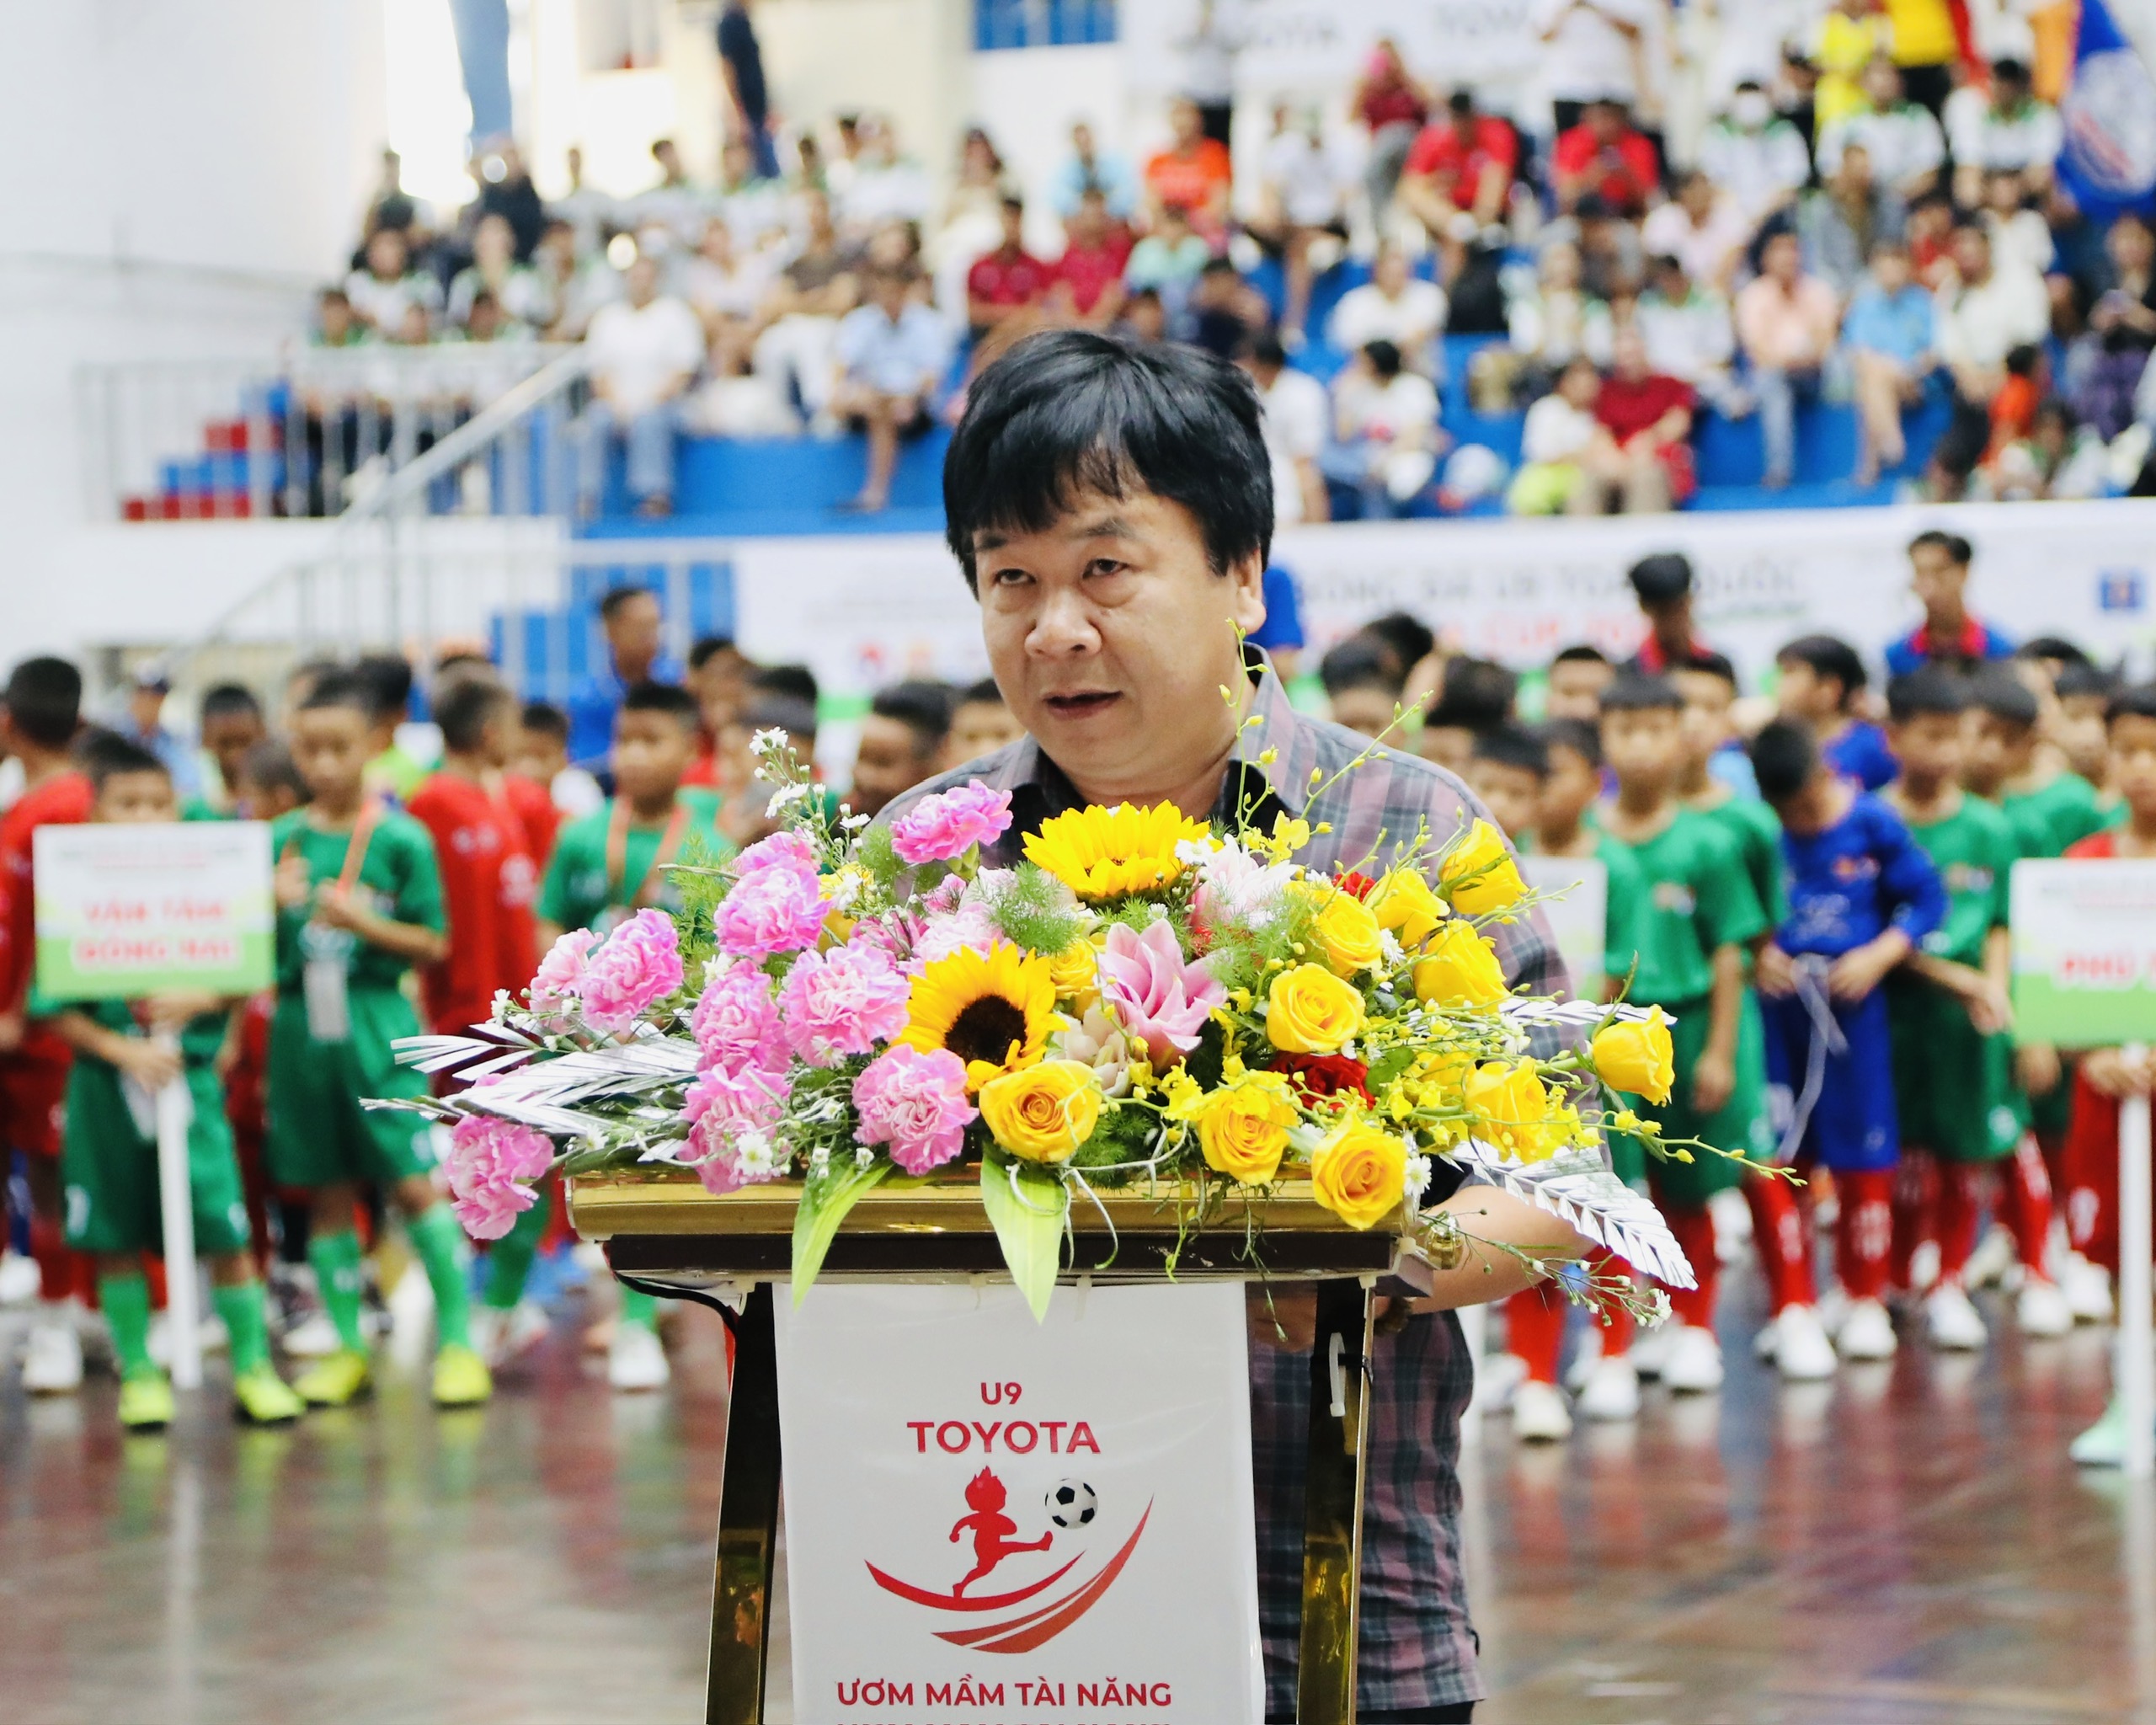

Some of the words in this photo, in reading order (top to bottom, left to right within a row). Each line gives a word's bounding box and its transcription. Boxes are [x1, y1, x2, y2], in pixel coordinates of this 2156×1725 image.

[980, 1381, 1022, 1405] U9
[906, 1421, 1100, 1454] TOYOTA
[837, 1679, 914, 1706] ƯƠM
[926, 1674, 1005, 1706] MẦM
[1015, 1677, 1065, 1706] TÀI
[1077, 1678, 1171, 1706] NĂNG
